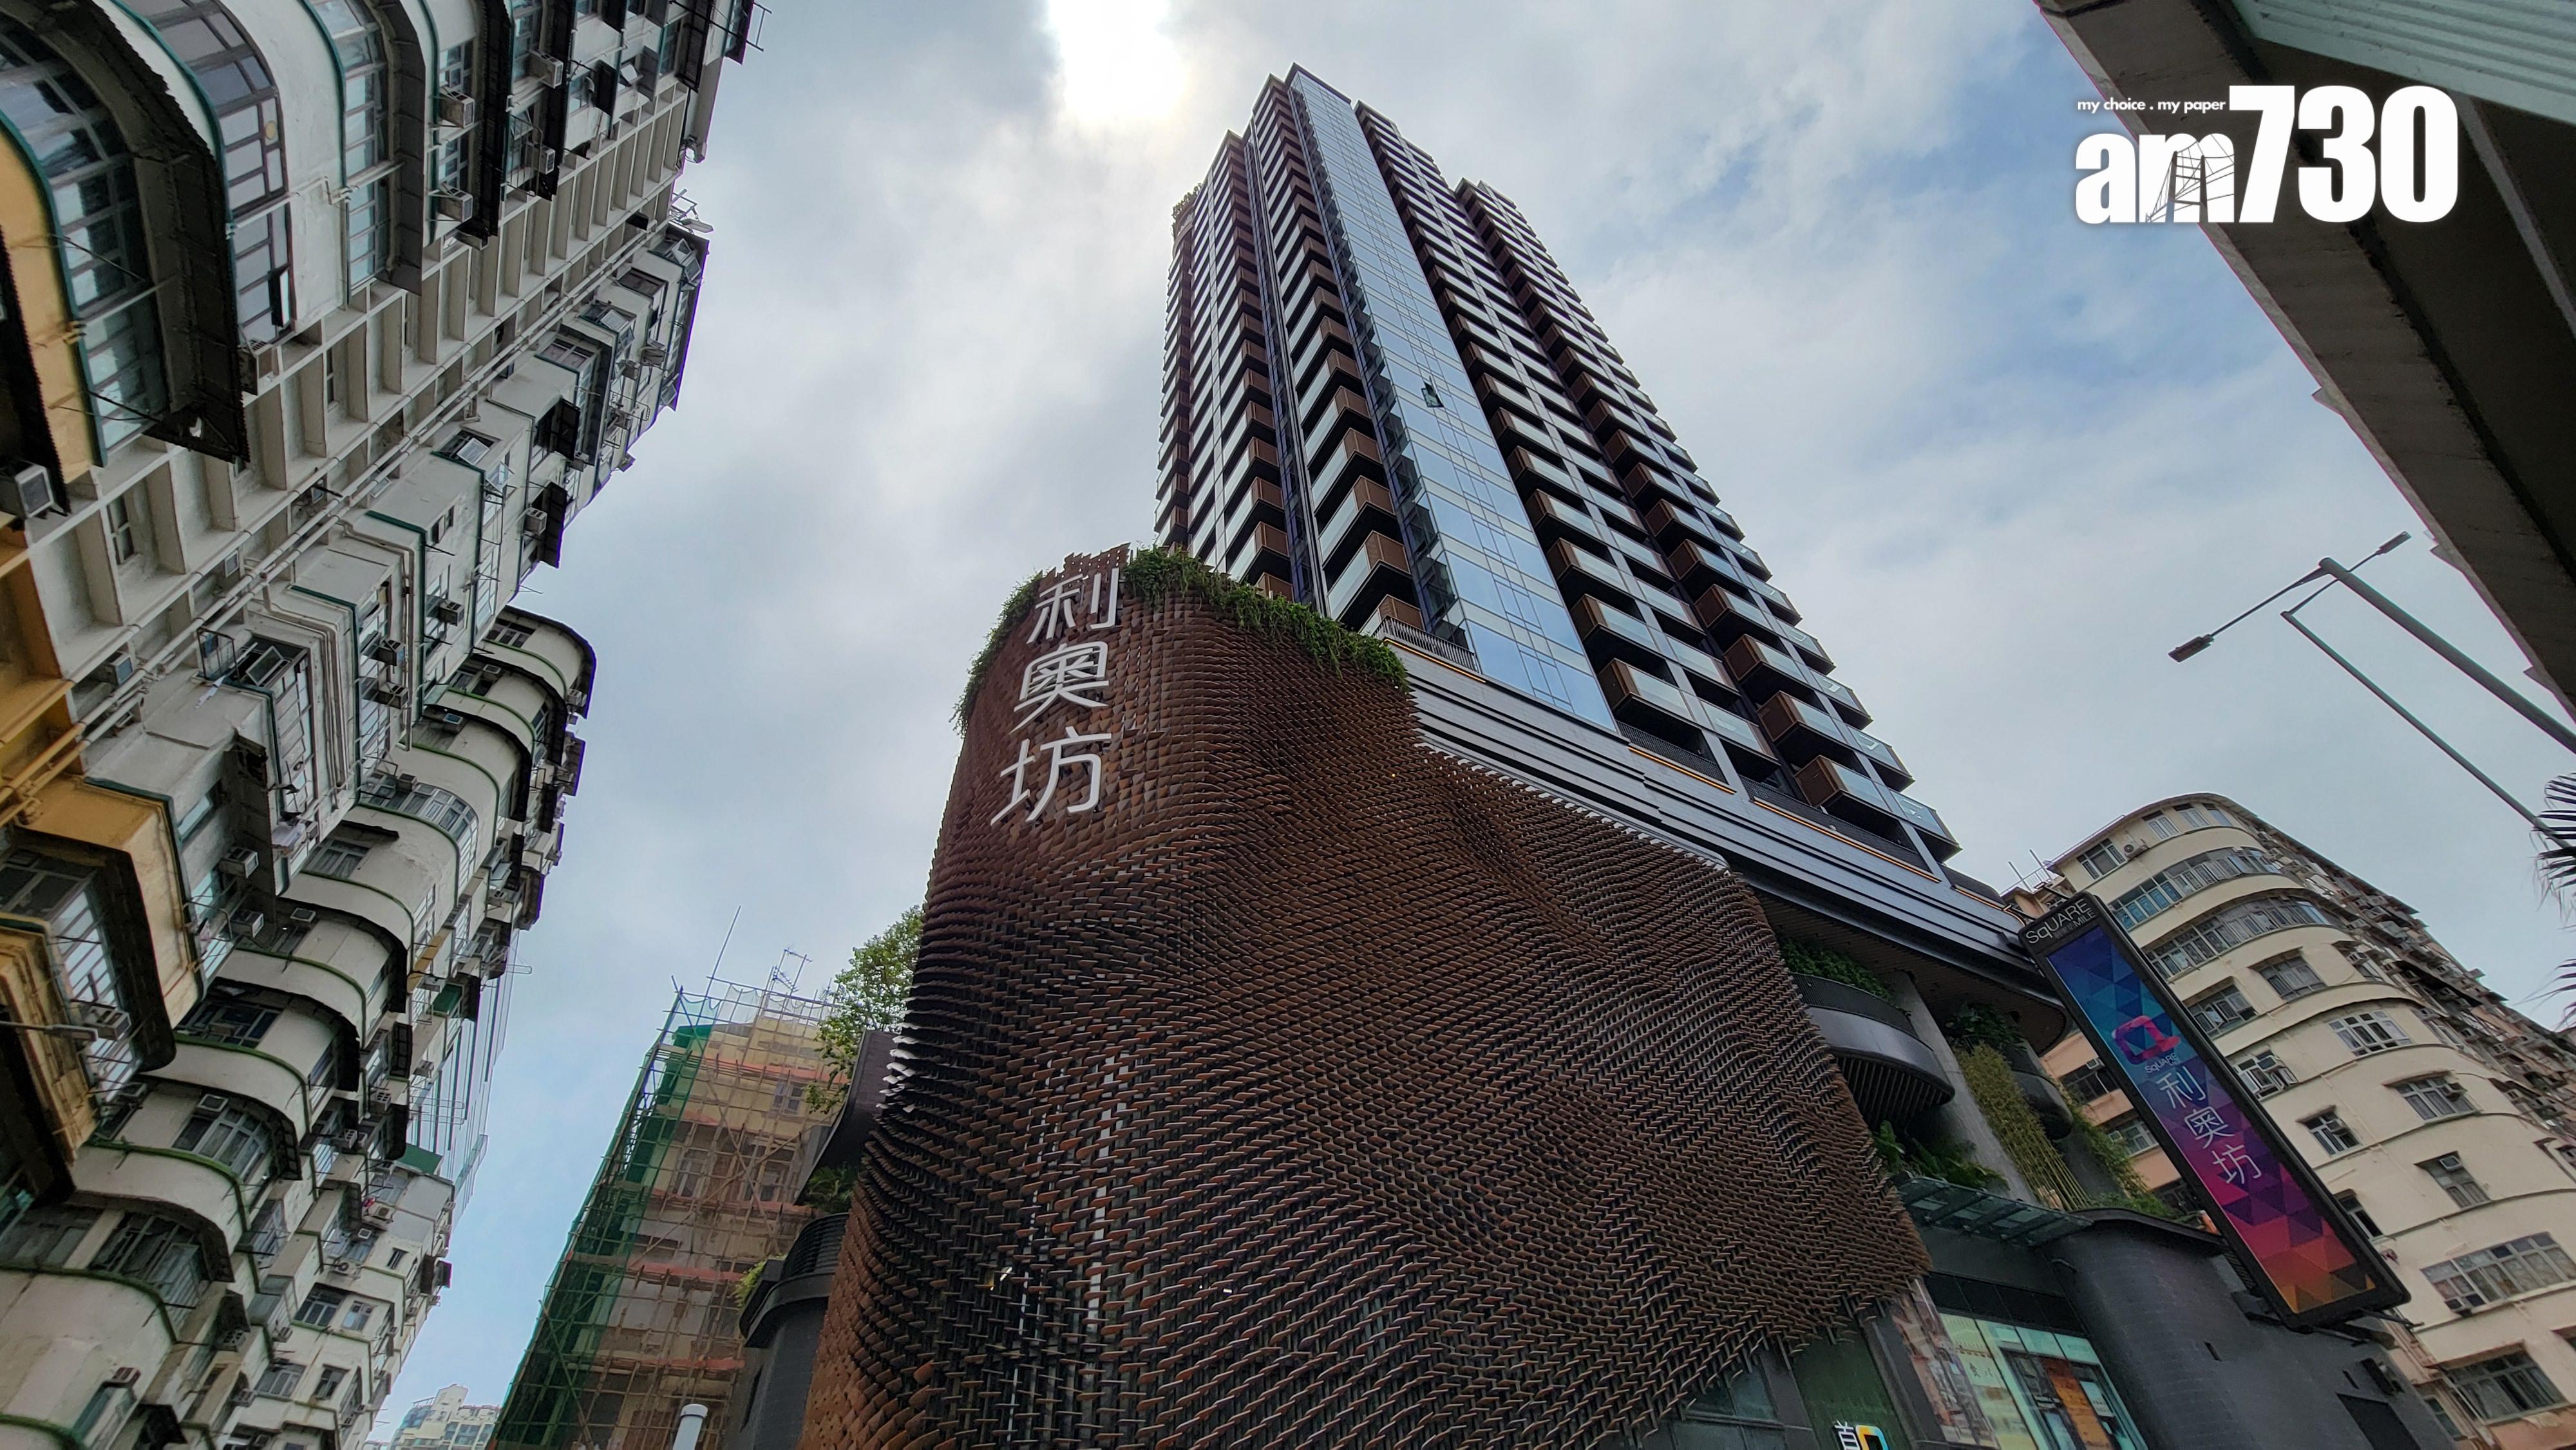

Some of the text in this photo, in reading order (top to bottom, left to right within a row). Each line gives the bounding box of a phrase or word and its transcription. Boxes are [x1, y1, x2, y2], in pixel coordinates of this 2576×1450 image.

[990, 568, 1120, 826] 利奧坊
[2156, 1066, 2262, 1185] 利奧坊
